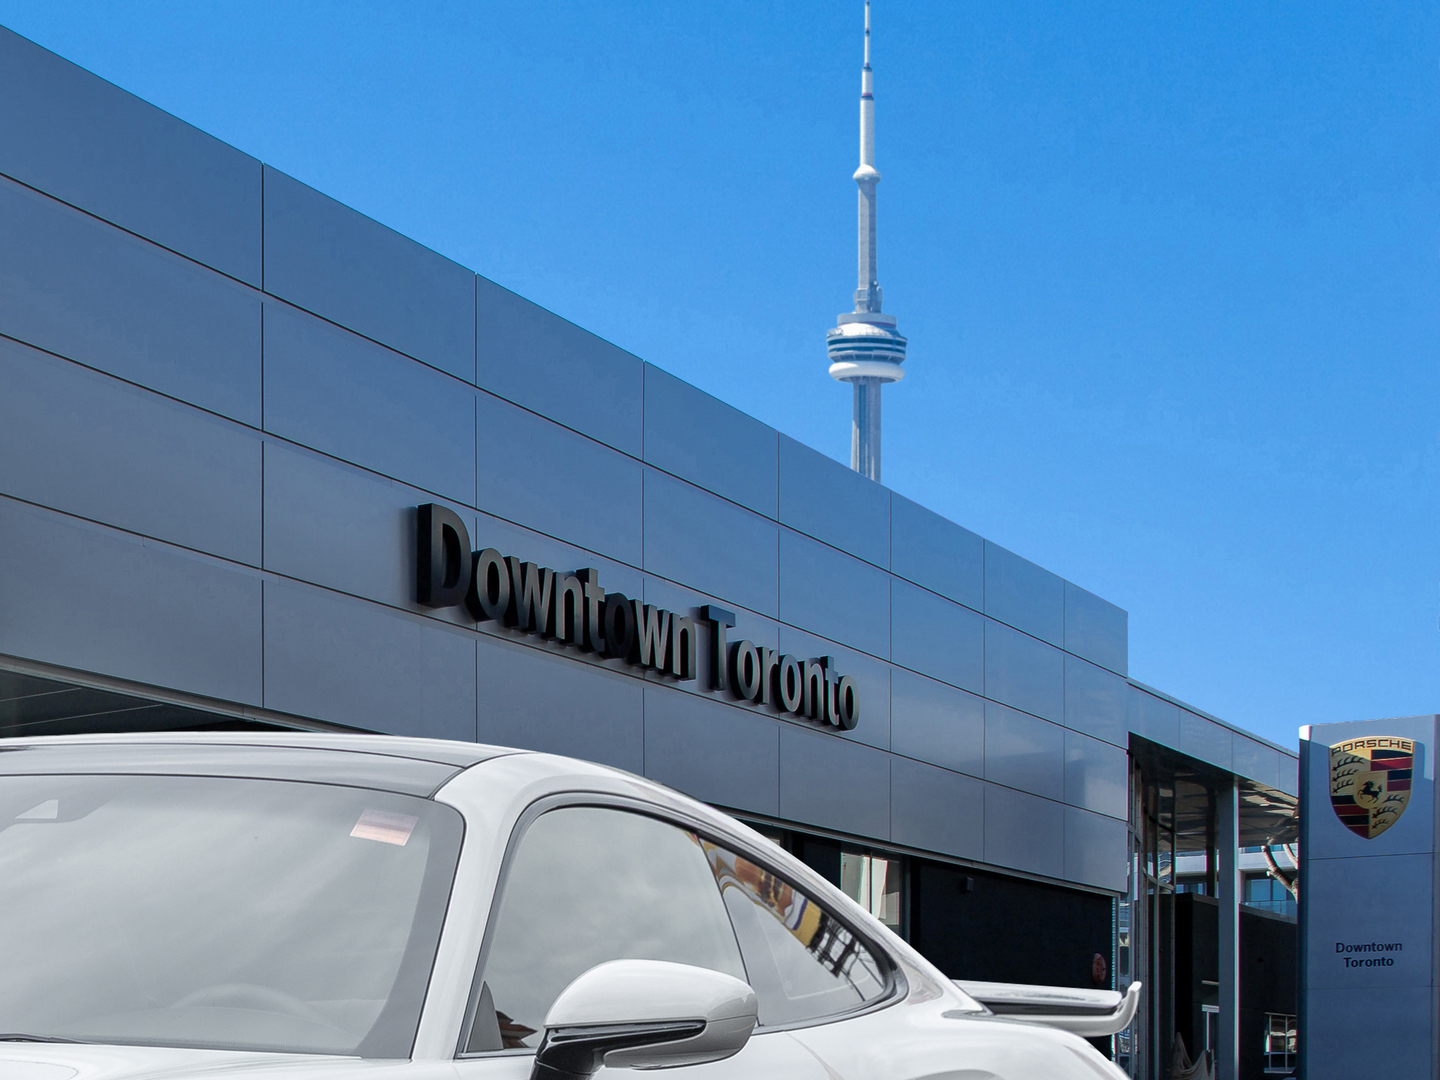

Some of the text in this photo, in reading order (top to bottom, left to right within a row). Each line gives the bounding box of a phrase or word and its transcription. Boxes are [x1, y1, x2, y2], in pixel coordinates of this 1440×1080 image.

[416, 502, 859, 731] Downtown Toronto
[1331, 738, 1413, 757] PORSCHE
[1335, 941, 1403, 953] Downtown
[1343, 956, 1394, 968] Toronto
